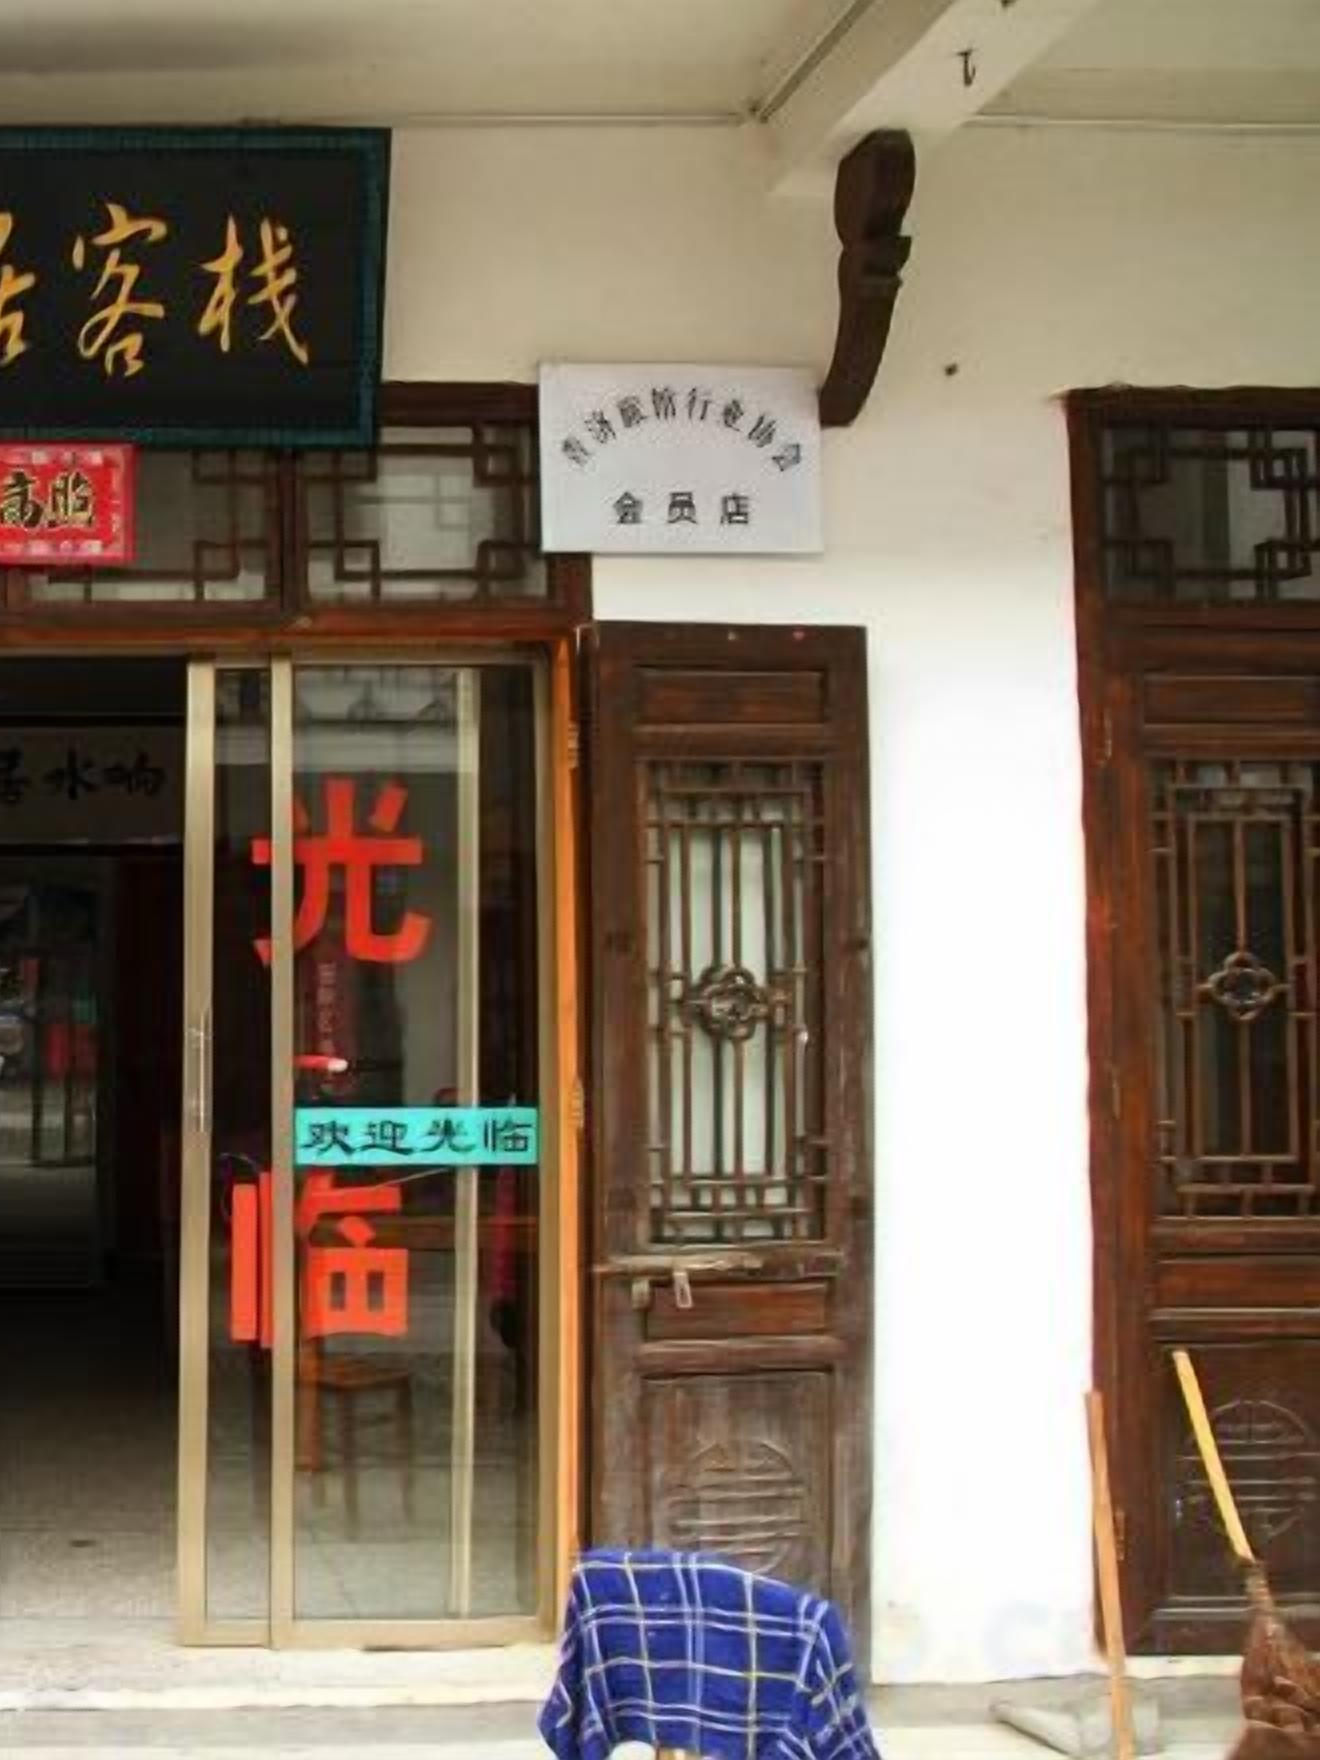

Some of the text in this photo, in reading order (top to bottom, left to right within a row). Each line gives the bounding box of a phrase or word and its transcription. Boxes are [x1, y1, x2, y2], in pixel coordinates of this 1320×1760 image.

[613, 491, 750, 525] 会员店
[300, 1117, 533, 1157] 欢迎光临
